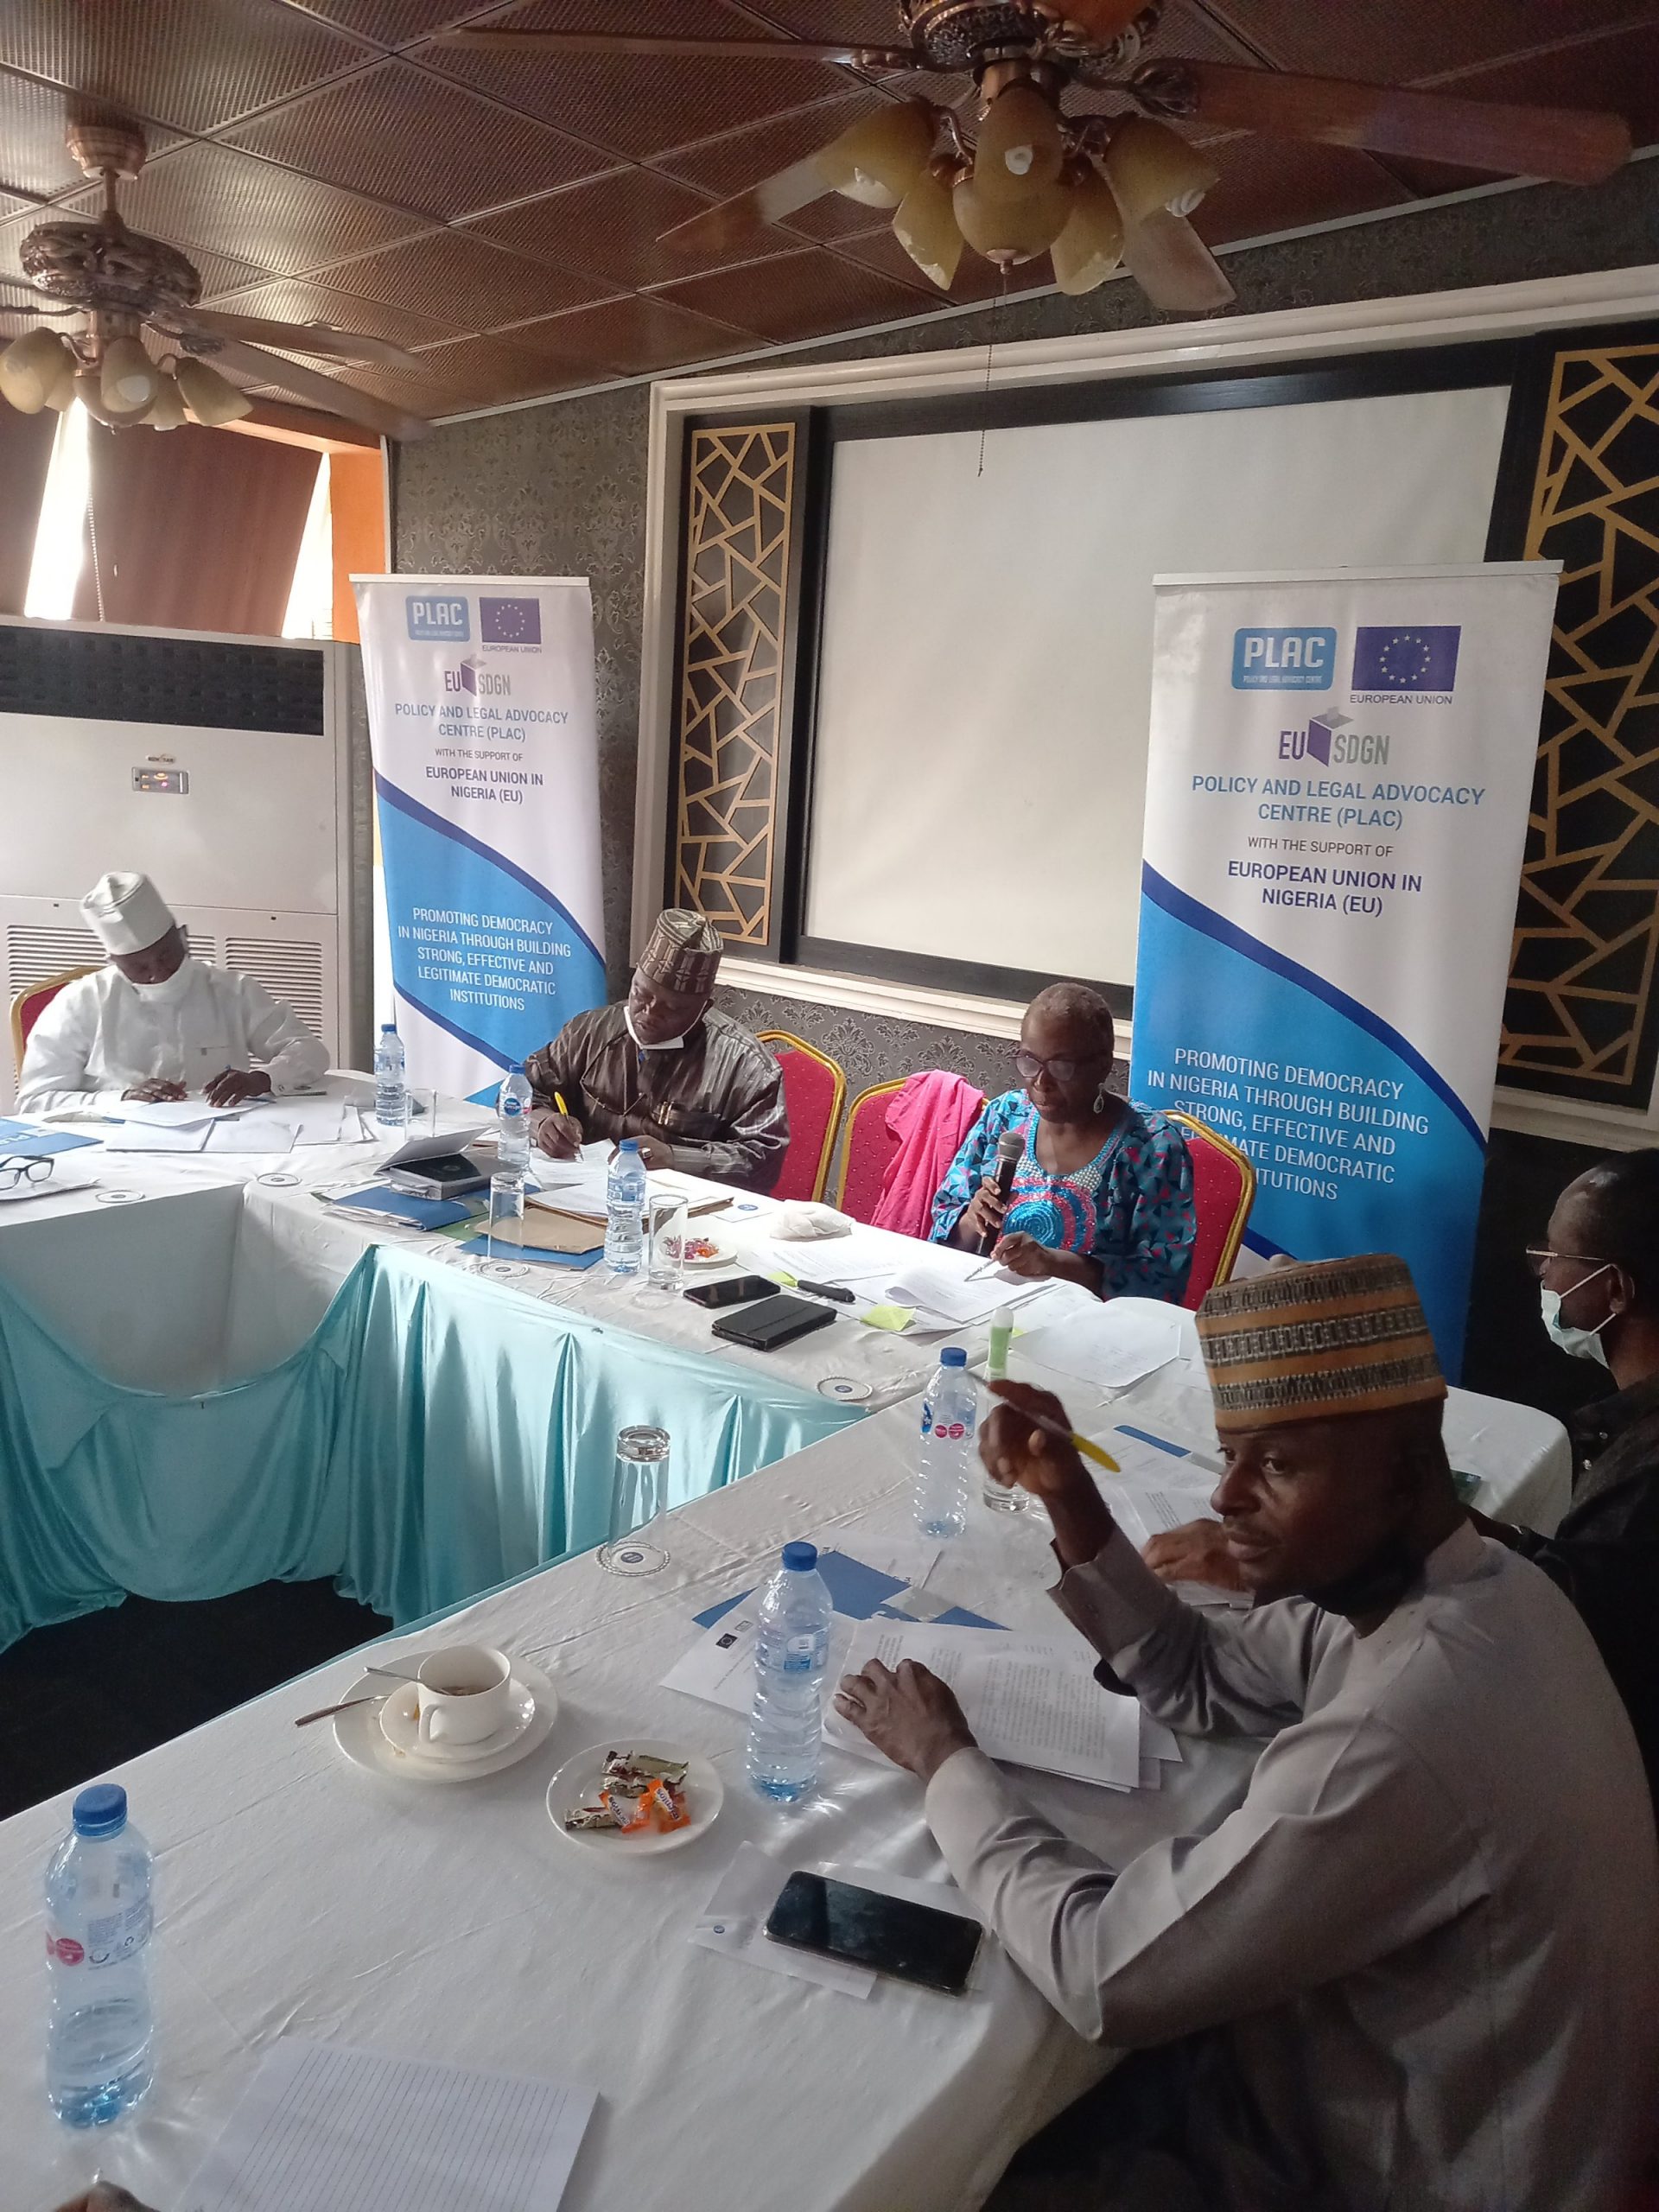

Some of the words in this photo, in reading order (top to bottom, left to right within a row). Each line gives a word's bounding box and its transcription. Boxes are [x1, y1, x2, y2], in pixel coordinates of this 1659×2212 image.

[413, 602, 463, 626] PLAC
[482, 645, 518, 653] EUROPEAN
[1244, 636, 1325, 668] PLAC
[444, 671, 461, 692] EU
[478, 674, 512, 695] SDGN
[395, 703, 435, 717] POLICY
[439, 705, 463, 719] AND
[467, 707, 502, 721] LEGAL
[505, 709, 569, 724] ADVOCACY
[1350, 694, 1413, 704] EUROPEAN
[1415, 695, 1453, 705] UNION
[439, 724, 484, 738] CENTRE
[487, 727, 525, 743] (PLAC)
[435, 748, 455, 758] WITH
[458, 749, 474, 759] THE
[475, 750, 510, 760] SUPPORT
[512, 753, 524, 761] OF
[1278, 730, 1306, 760] EU
[1333, 734, 1390, 766] SDGN
[426, 766, 486, 783] EUROPEAN
[491, 771, 529, 785] UNION
[531, 772, 543, 785] IN
[451, 786, 496, 800] NIGERIA
[499, 790, 524, 804] (EU)
[1192, 775, 1258, 794] POLICY
[1262, 779, 1302, 797] AND
[1306, 781, 1366, 800] LEGAL
[1371, 784, 1486, 806] ADVOCACY
[1258, 804, 1332, 823] CENTRE
[1337, 807, 1403, 831] (PLAC)
[1248, 836, 1279, 850] WITH
[1281, 838, 1307, 852] THE
[1310, 841, 1372, 856] SUPPORT
[1375, 845, 1395, 858] OF
[1228, 861, 1327, 885] EUROPEAN
[1332, 868, 1395, 890] UNION
[1402, 874, 1422, 893] IN
[1262, 888, 1338, 911] NIGERIA
[1343, 894, 1383, 918] (EU)
[413, 907, 479, 927] PROMOTING
[482, 915, 553, 935] DEMOCRACY
[398, 926, 410, 938] IN
[413, 928, 458, 944] NIGERIA
[460, 931, 514, 951] THROUGH
[517, 938, 572, 957] BUILDING
[417, 947, 465, 966] STRONG,
[467, 954, 525, 972] EFFECTIVE
[529, 961, 554, 976] AND
[418, 966, 481, 985] LEGITIMATE
[484, 973, 556, 995] DEMOCRATIC
[450, 988, 525, 1011] INSTITUTIONS
[1174, 1048, 1280, 1082] PROMOTING
[1284, 1065, 1404, 1101] DEMOCRACY
[1147, 1070, 1165, 1088] IN
[1170, 1073, 1239, 1101] NIGERIA
[1244, 1086, 1334, 1118] THROUGH
[1338, 1101, 1429, 1135] BUILDING
[1173, 1100, 1248, 1132] STRONG,
[1252, 1115, 1347, 1148] EFFECTIVE
[1353, 1132, 1396, 1156] AND
[1274, 1144, 1395, 1185] DEMOCRATIC
[1255, 1168, 1338, 1201] ITUTIONS
